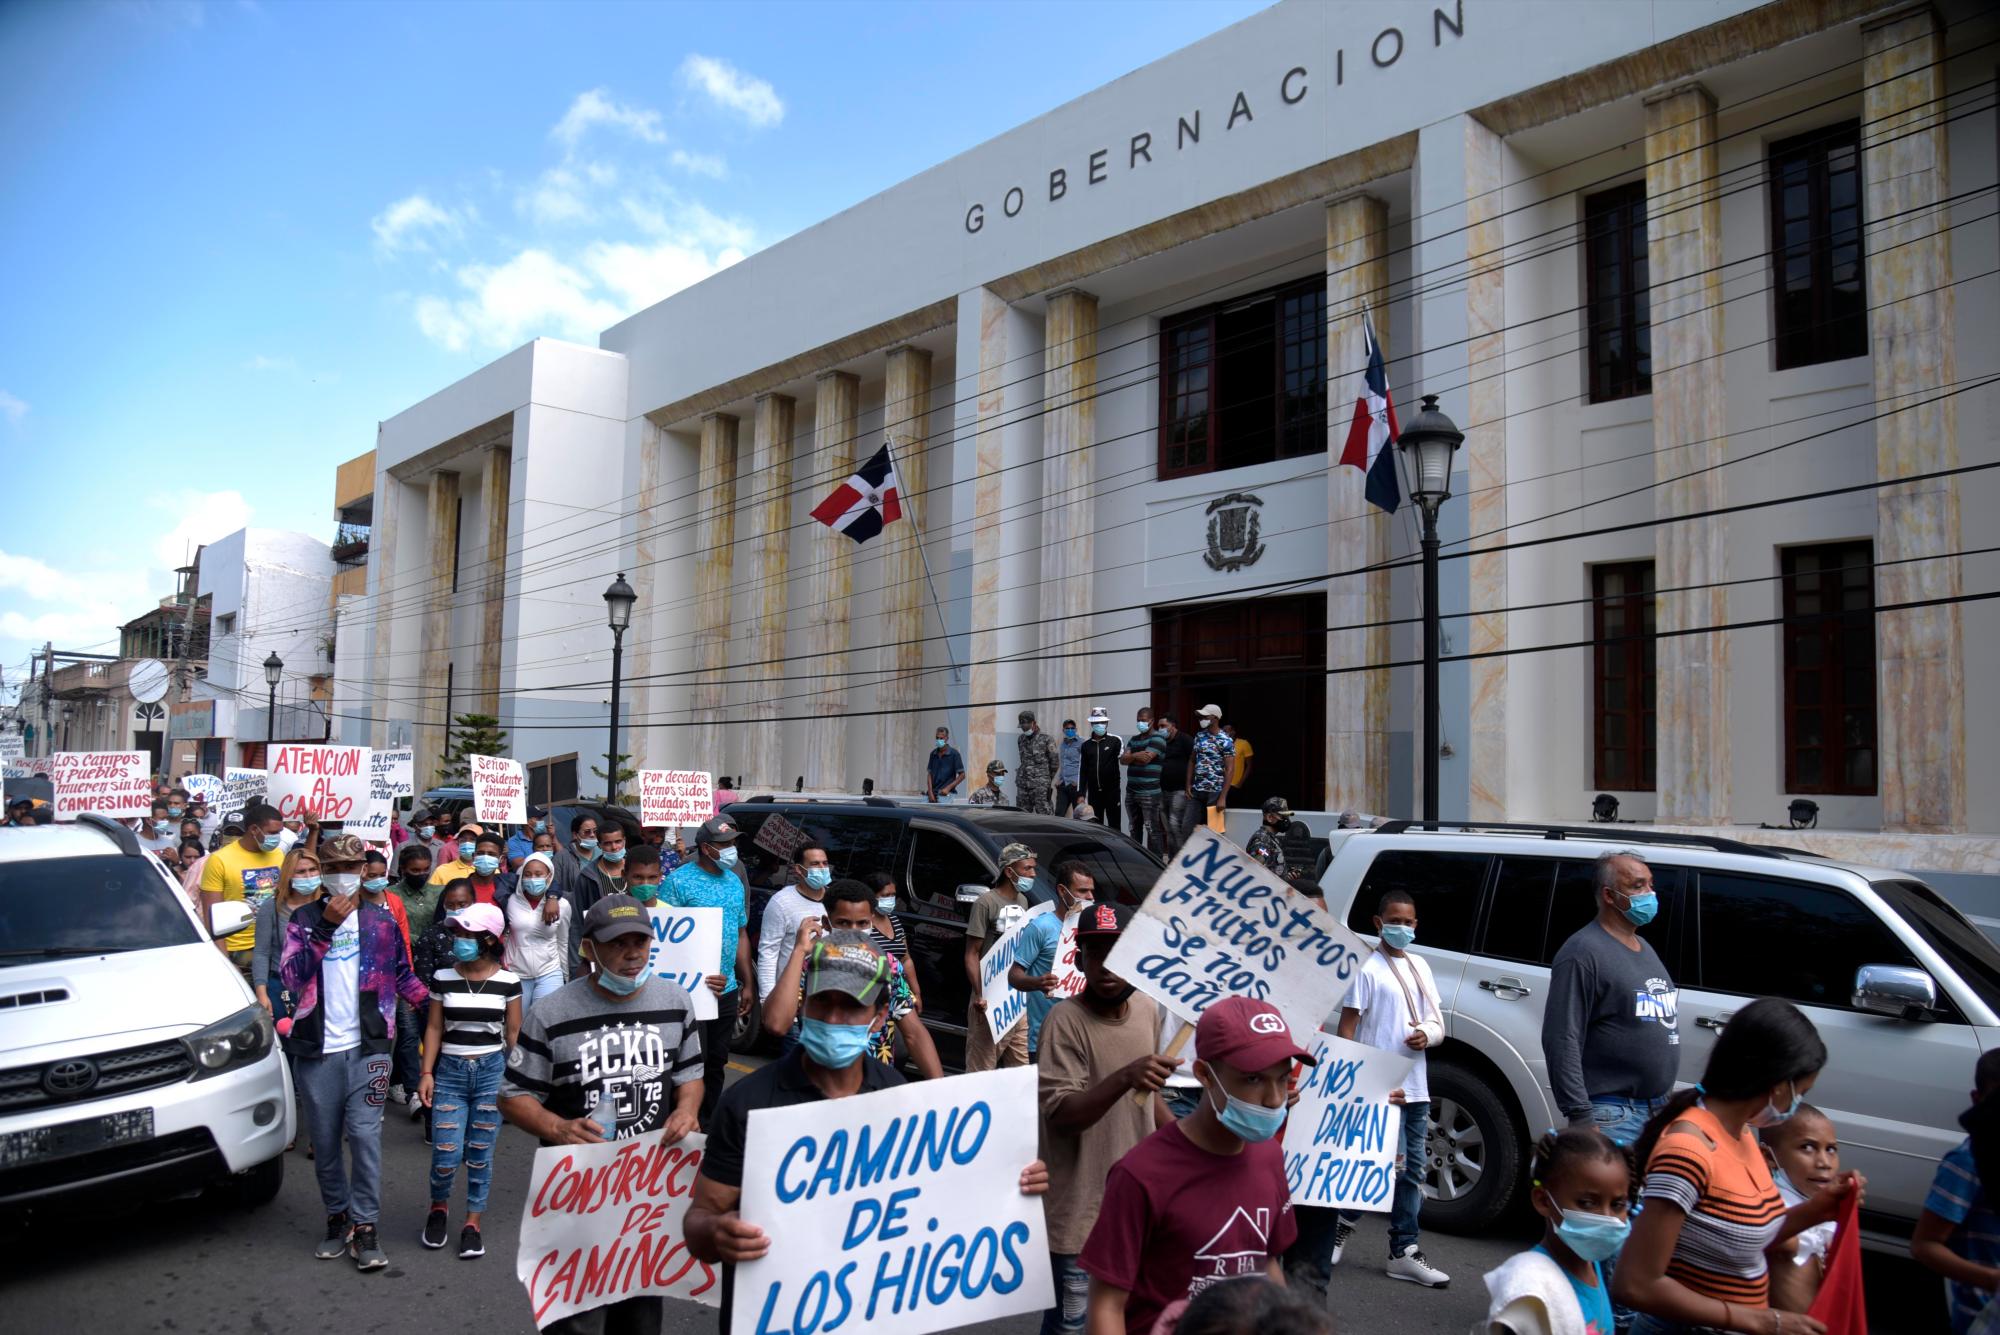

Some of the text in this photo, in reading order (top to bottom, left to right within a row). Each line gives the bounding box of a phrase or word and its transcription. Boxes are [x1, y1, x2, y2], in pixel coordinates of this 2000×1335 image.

[965, 0, 1464, 233] GOBERNACION
[273, 746, 360, 776] ATENCION
[665, 770, 708, 784] decadas
[56, 777, 151, 794] mueren sin los
[312, 777, 336, 797] AL
[474, 771, 522, 785] Presidente
[481, 784, 519, 797] Abinader
[678, 785, 708, 797] sidos
[58, 794, 151, 811] CAMPESINOS
[278, 793, 353, 820] CAMPO
[485, 798, 511, 808] no nos
[1160, 873, 1286, 972] Frutos
[1181, 838, 1359, 981] Nuestros
[1136, 954, 1222, 1012] dañ
[1204, 952, 1270, 1000] nos
[643, 1082, 663, 1101] 72
[1318, 1058, 1364, 1099] NOS
[775, 1101, 991, 1203] CAMINO
[1305, 1152, 1393, 1205] FRUTOS
[620, 1203, 669, 1236] DE
[842, 1187, 921, 1250] DE
[530, 1233, 716, 1322] CAMINOS
[755, 1261, 857, 1335] LOS
